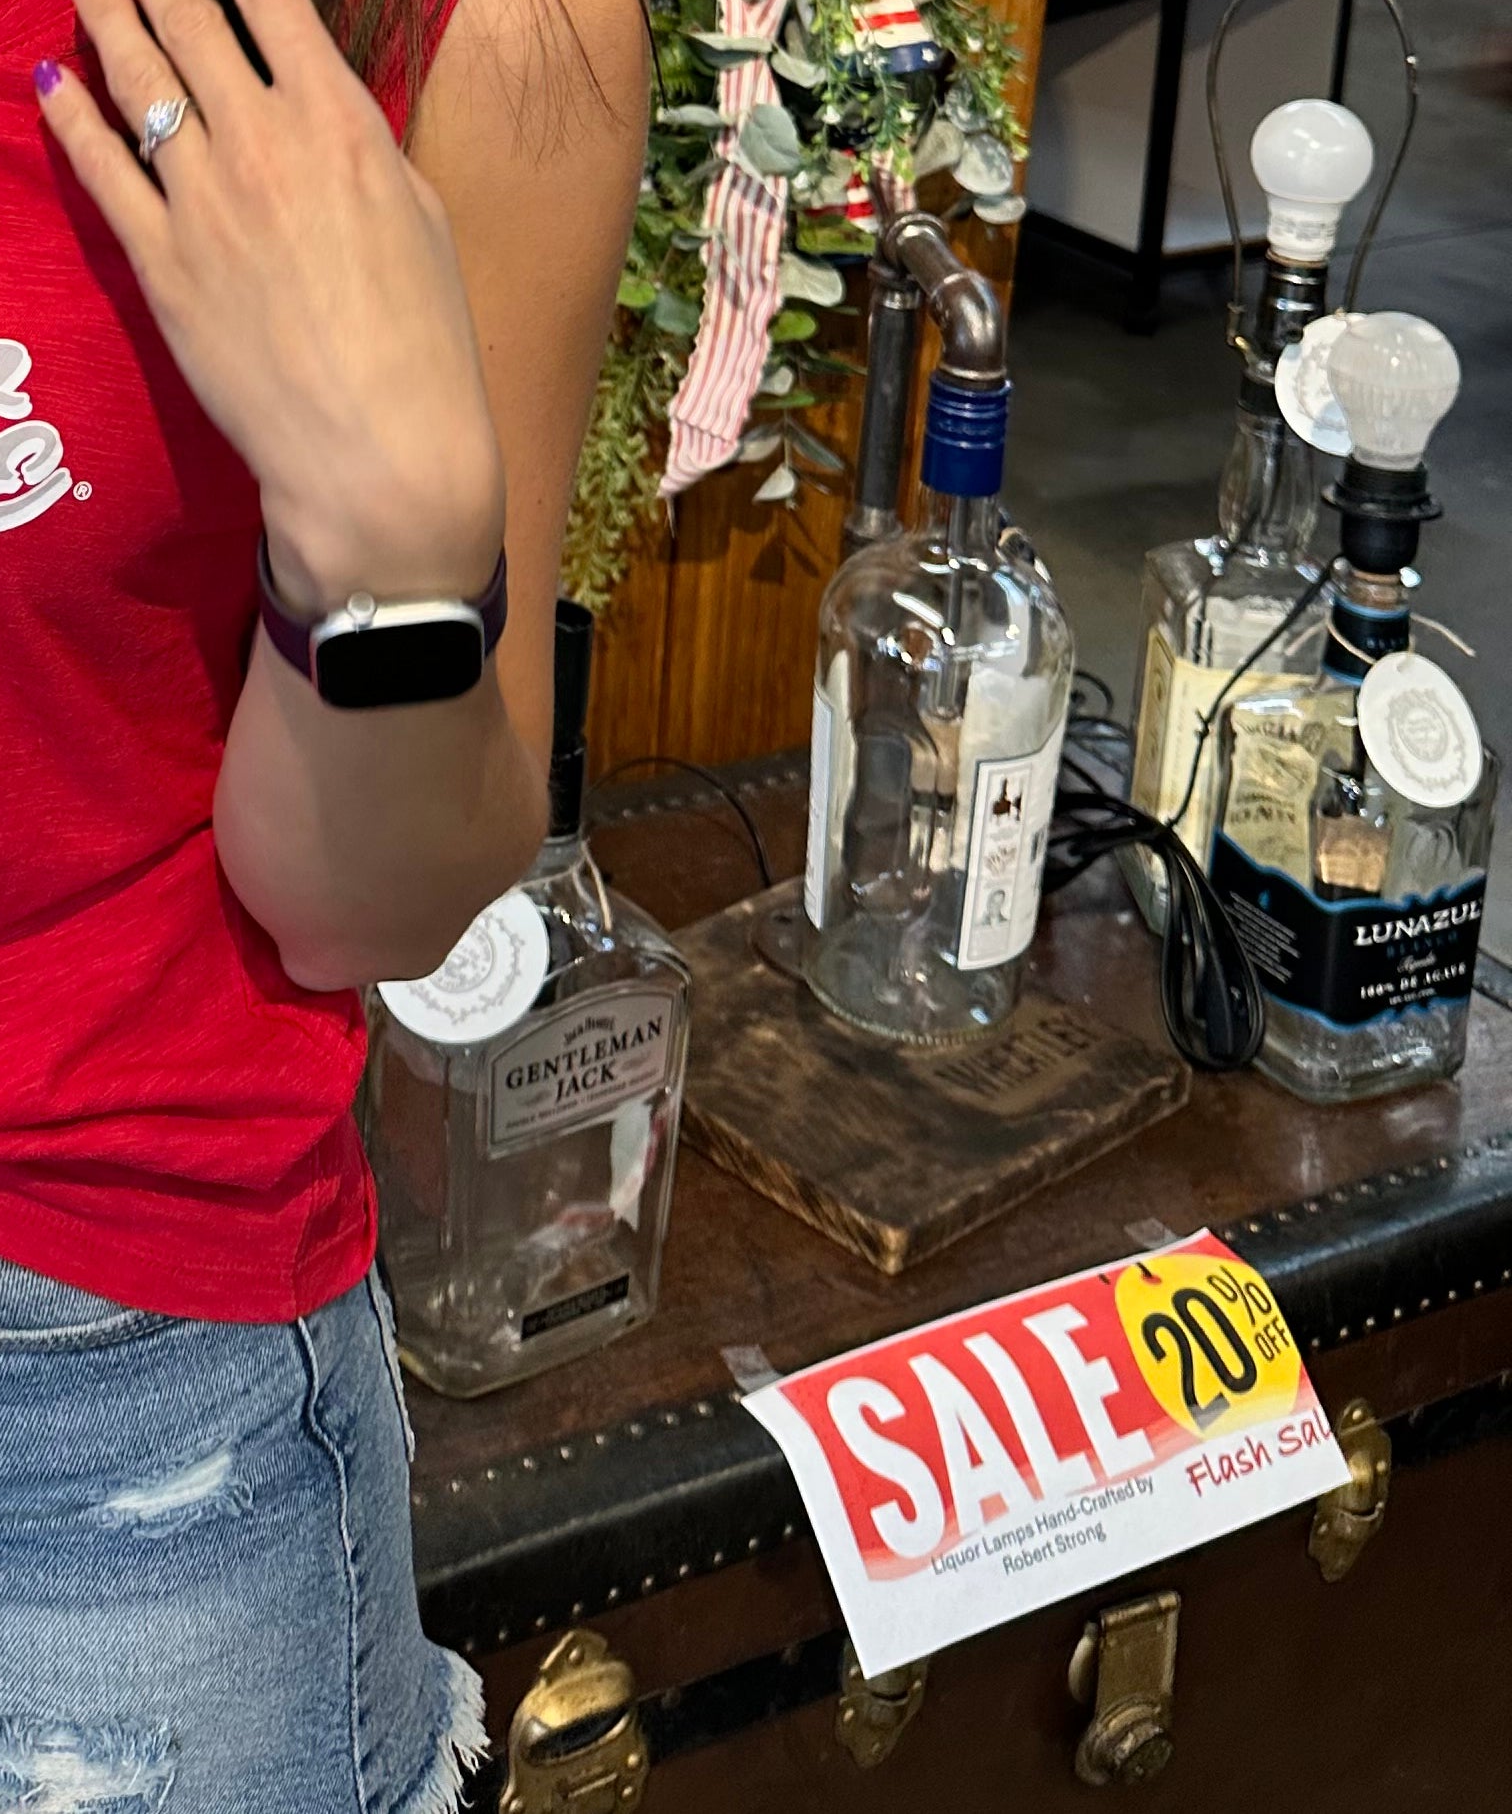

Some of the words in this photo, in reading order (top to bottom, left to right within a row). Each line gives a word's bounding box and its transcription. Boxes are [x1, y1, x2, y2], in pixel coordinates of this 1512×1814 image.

[1353, 903, 1482, 948] LUNAZUL
[505, 1015, 663, 1090] GENTLEMAN
[555, 1061, 616, 1103] JACK
[1254, 1316, 1291, 1362] OFF
[826, 1303, 1156, 1560] SALE
[1141, 1265, 1273, 1432] 20%
[1185, 1435, 1274, 1498] Flash
[930, 1543, 982, 1577] Liquor
[982, 1523, 1036, 1559] Lamps
[1034, 1480, 1136, 1535] Hand-Crafted
[1136, 1475, 1156, 1497] by
[1001, 1540, 1055, 1576] Robert
[1053, 1520, 1108, 1556] Strong
